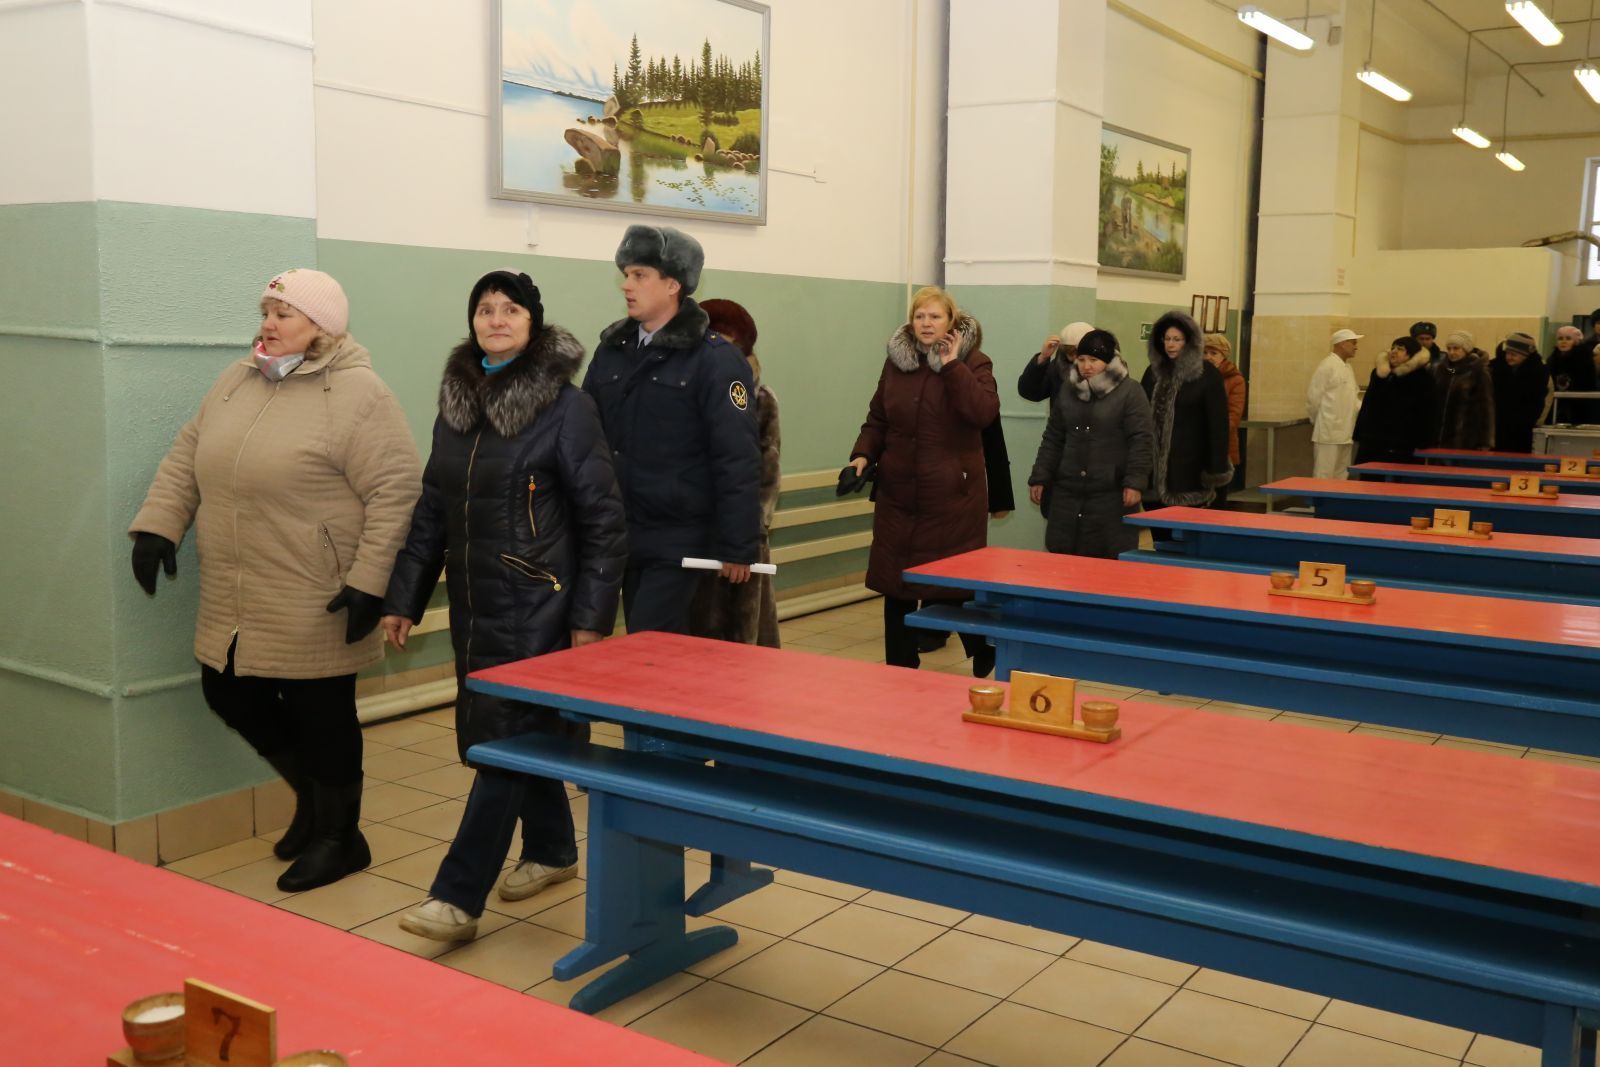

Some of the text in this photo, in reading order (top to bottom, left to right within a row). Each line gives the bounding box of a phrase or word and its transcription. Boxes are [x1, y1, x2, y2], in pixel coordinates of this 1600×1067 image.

[1567, 461, 1578, 472] 2
[1518, 478, 1529, 491] 3
[1441, 514, 1456, 528] 4
[1311, 568, 1331, 587] 5
[1029, 685, 1052, 714] 6
[211, 1007, 241, 1062] 7
